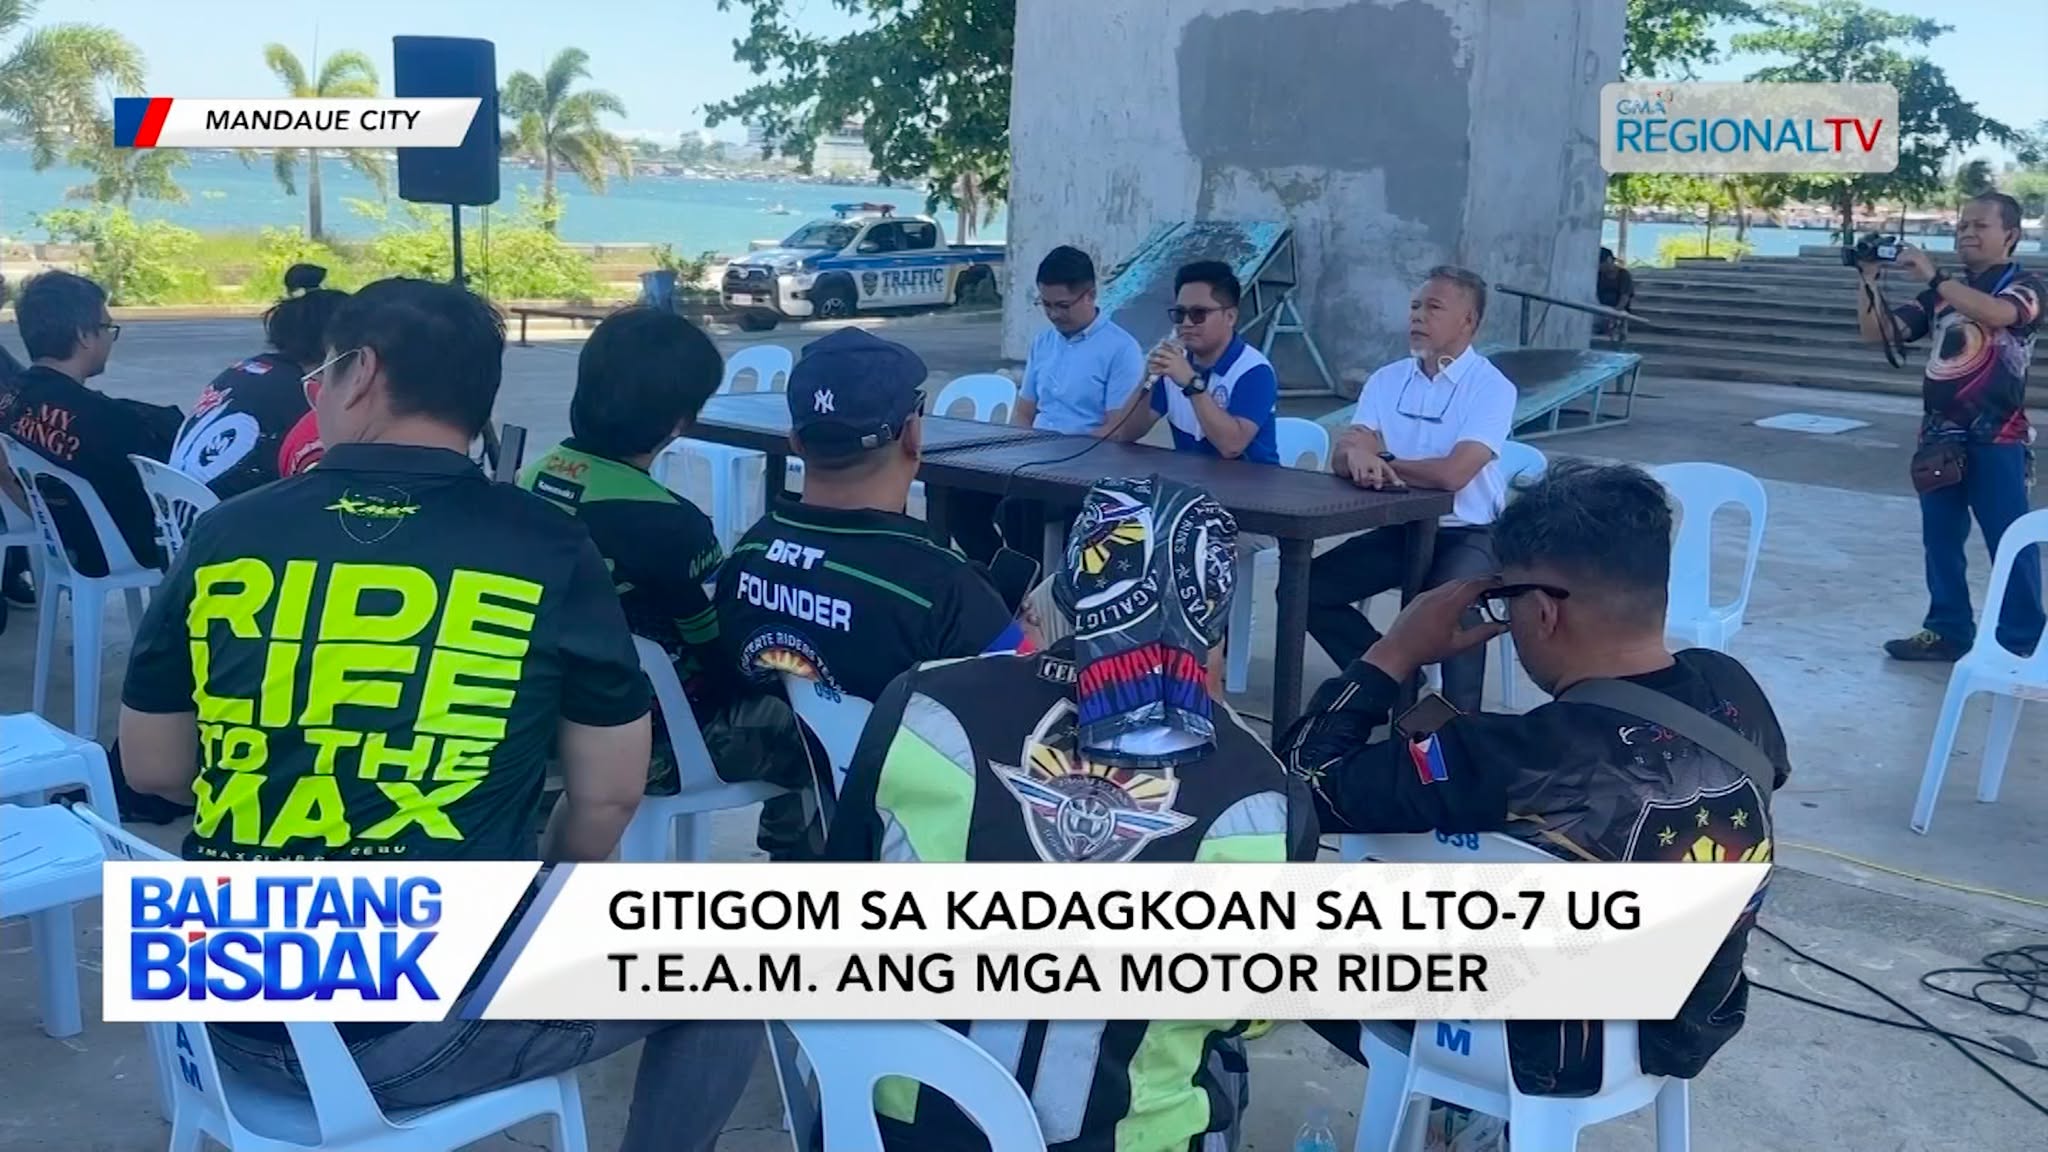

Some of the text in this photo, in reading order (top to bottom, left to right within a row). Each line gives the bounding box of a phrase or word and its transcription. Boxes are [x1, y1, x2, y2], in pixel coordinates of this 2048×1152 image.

[881, 268, 944, 289] TRAFFIC
[187, 557, 544, 657] RIDE
[737, 571, 852, 632] FOUNDER
[188, 639, 523, 739] LIFE
[197, 724, 500, 782] TO THE
[193, 772, 484, 848] MAX
